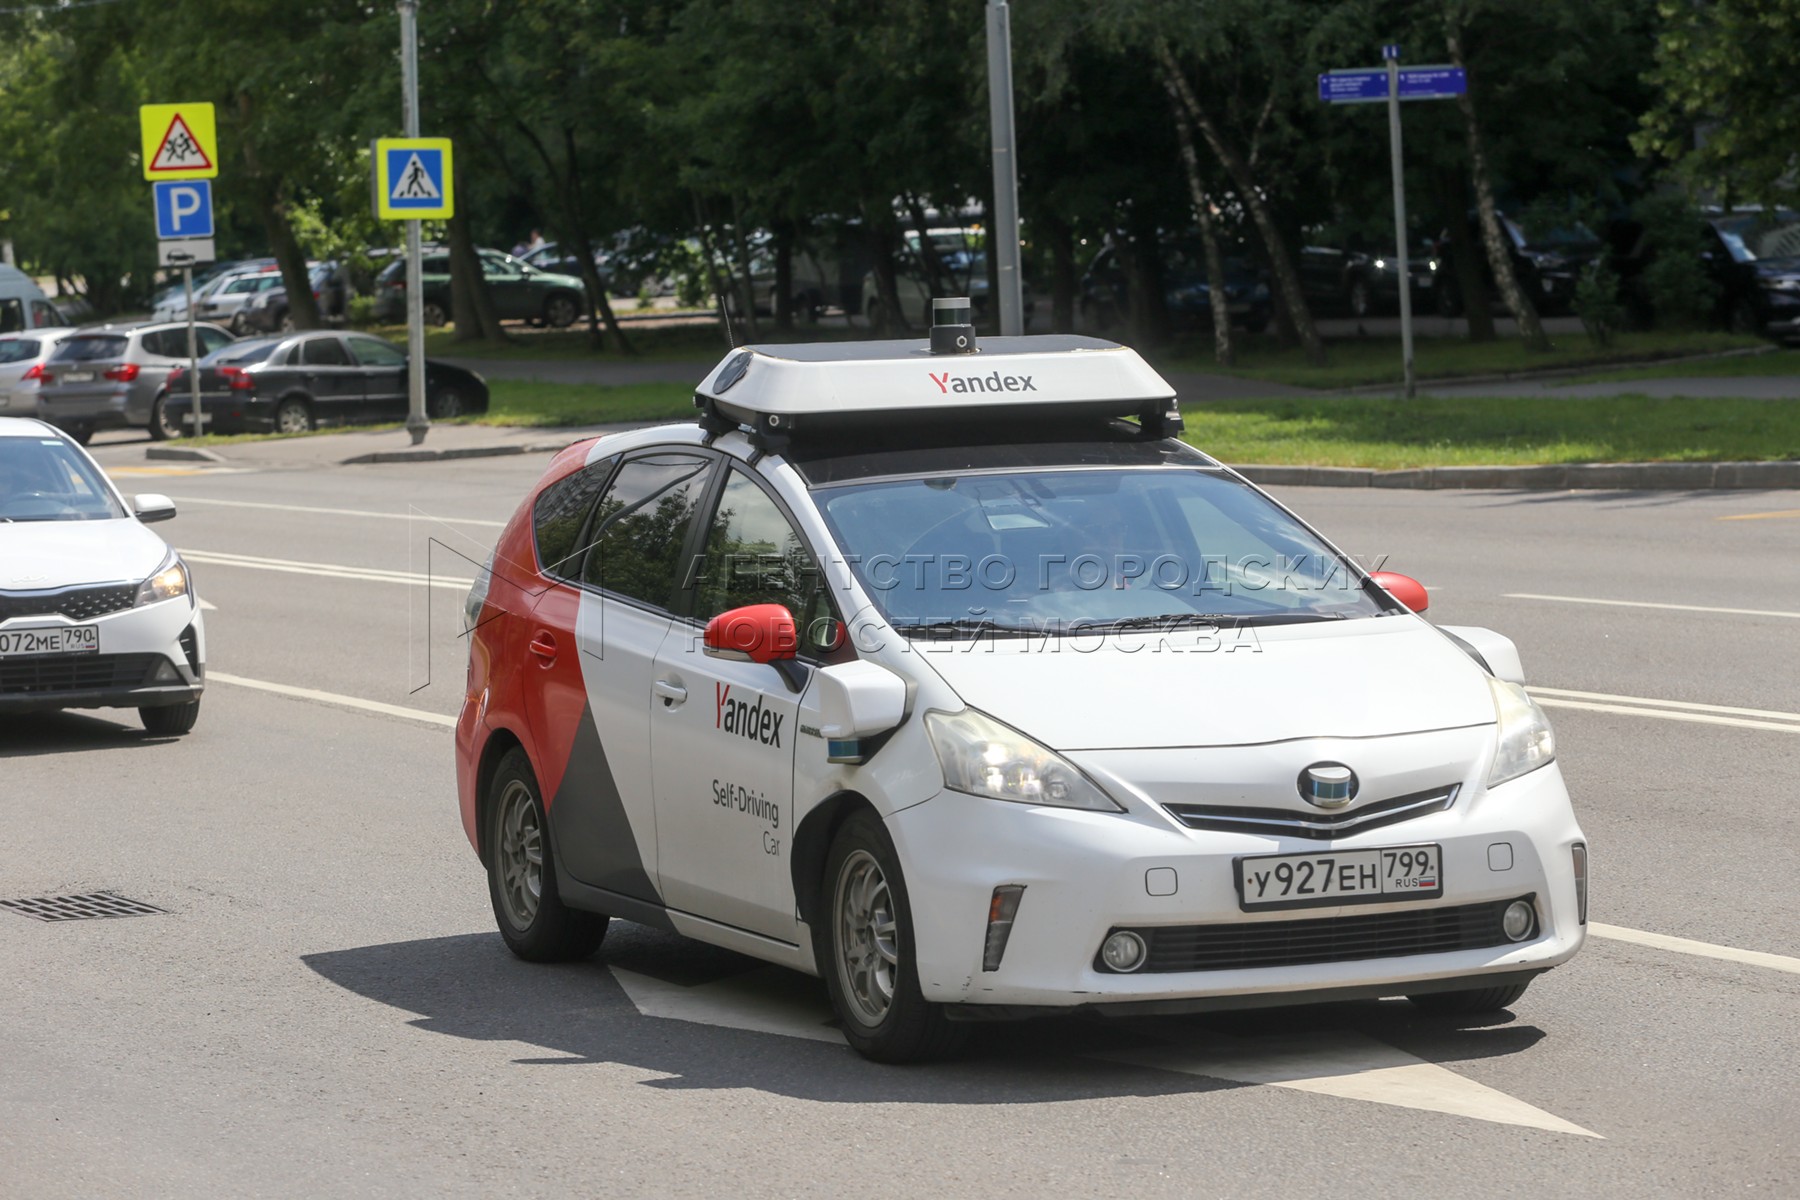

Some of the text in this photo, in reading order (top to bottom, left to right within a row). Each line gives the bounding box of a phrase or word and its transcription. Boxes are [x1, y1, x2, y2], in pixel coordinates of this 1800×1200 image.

[170, 187, 201, 232] P
[928, 371, 1037, 391] Yandex
[64, 629, 92, 643] 790
[716, 681, 784, 748] Yandex
[712, 779, 779, 829] Self-Driving
[763, 831, 780, 856] Car
[1383, 851, 1430, 878] 799
[1395, 878, 1418, 888] RUS
